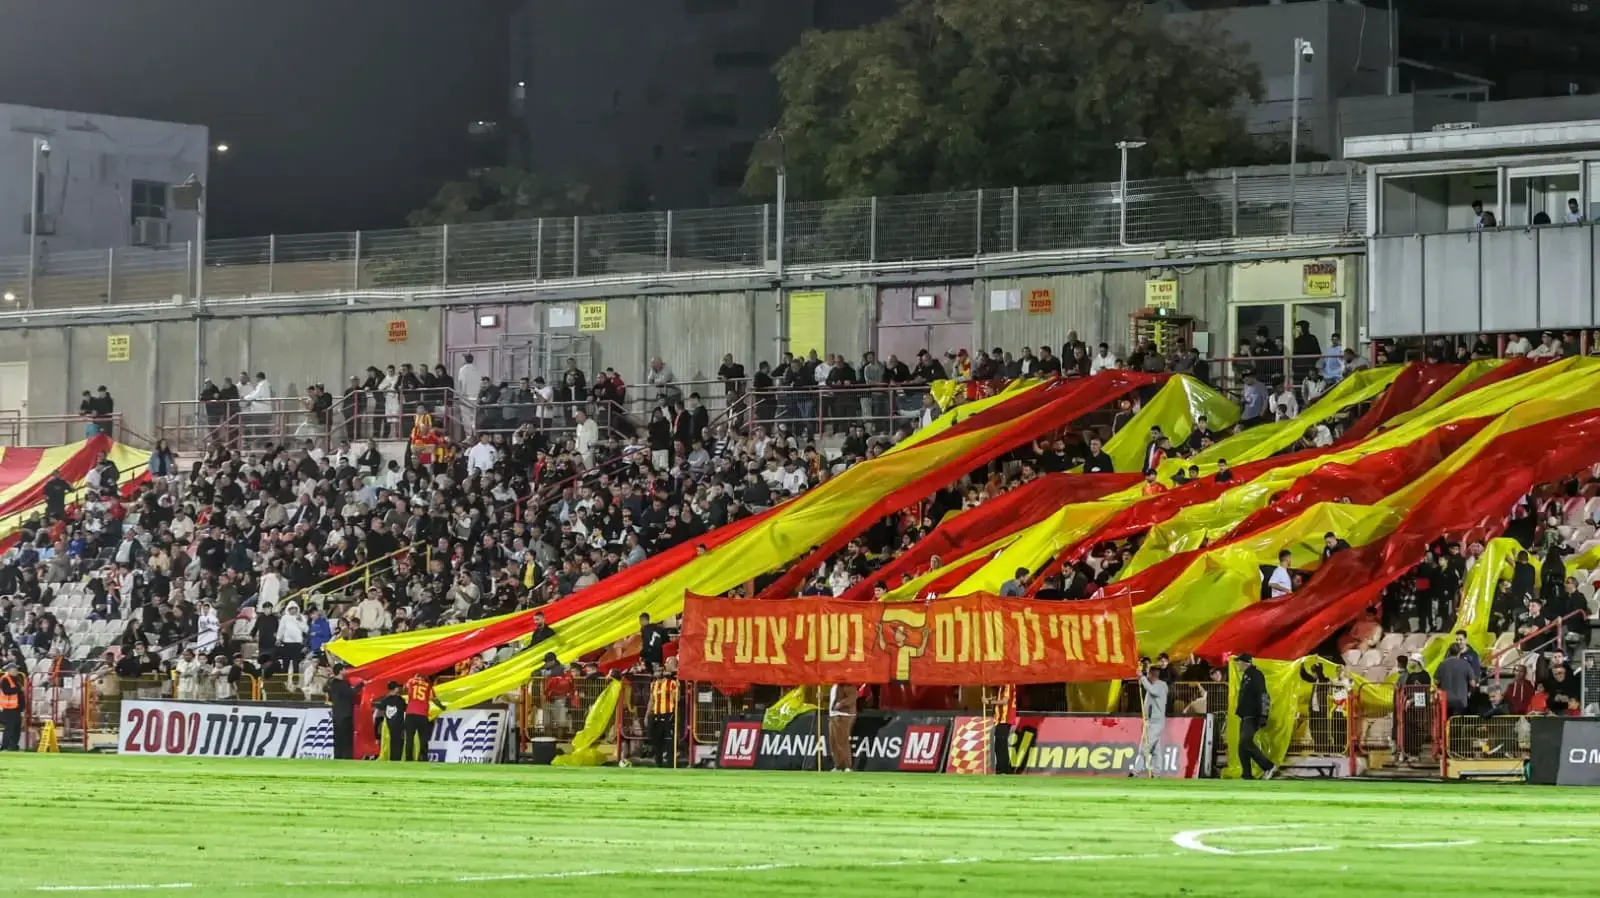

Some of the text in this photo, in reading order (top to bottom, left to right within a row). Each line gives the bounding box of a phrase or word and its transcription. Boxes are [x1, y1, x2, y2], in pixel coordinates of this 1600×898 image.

[704, 616, 787, 664] צבעים
[795, 613, 864, 662] בשני
[935, 606, 1004, 662] עולם
[1011, 607, 1045, 666] לך
[412, 685, 427, 701] 15
[725, 728, 758, 756] MJ
[760, 734, 827, 757] MANIA
[905, 732, 940, 759] MJ
